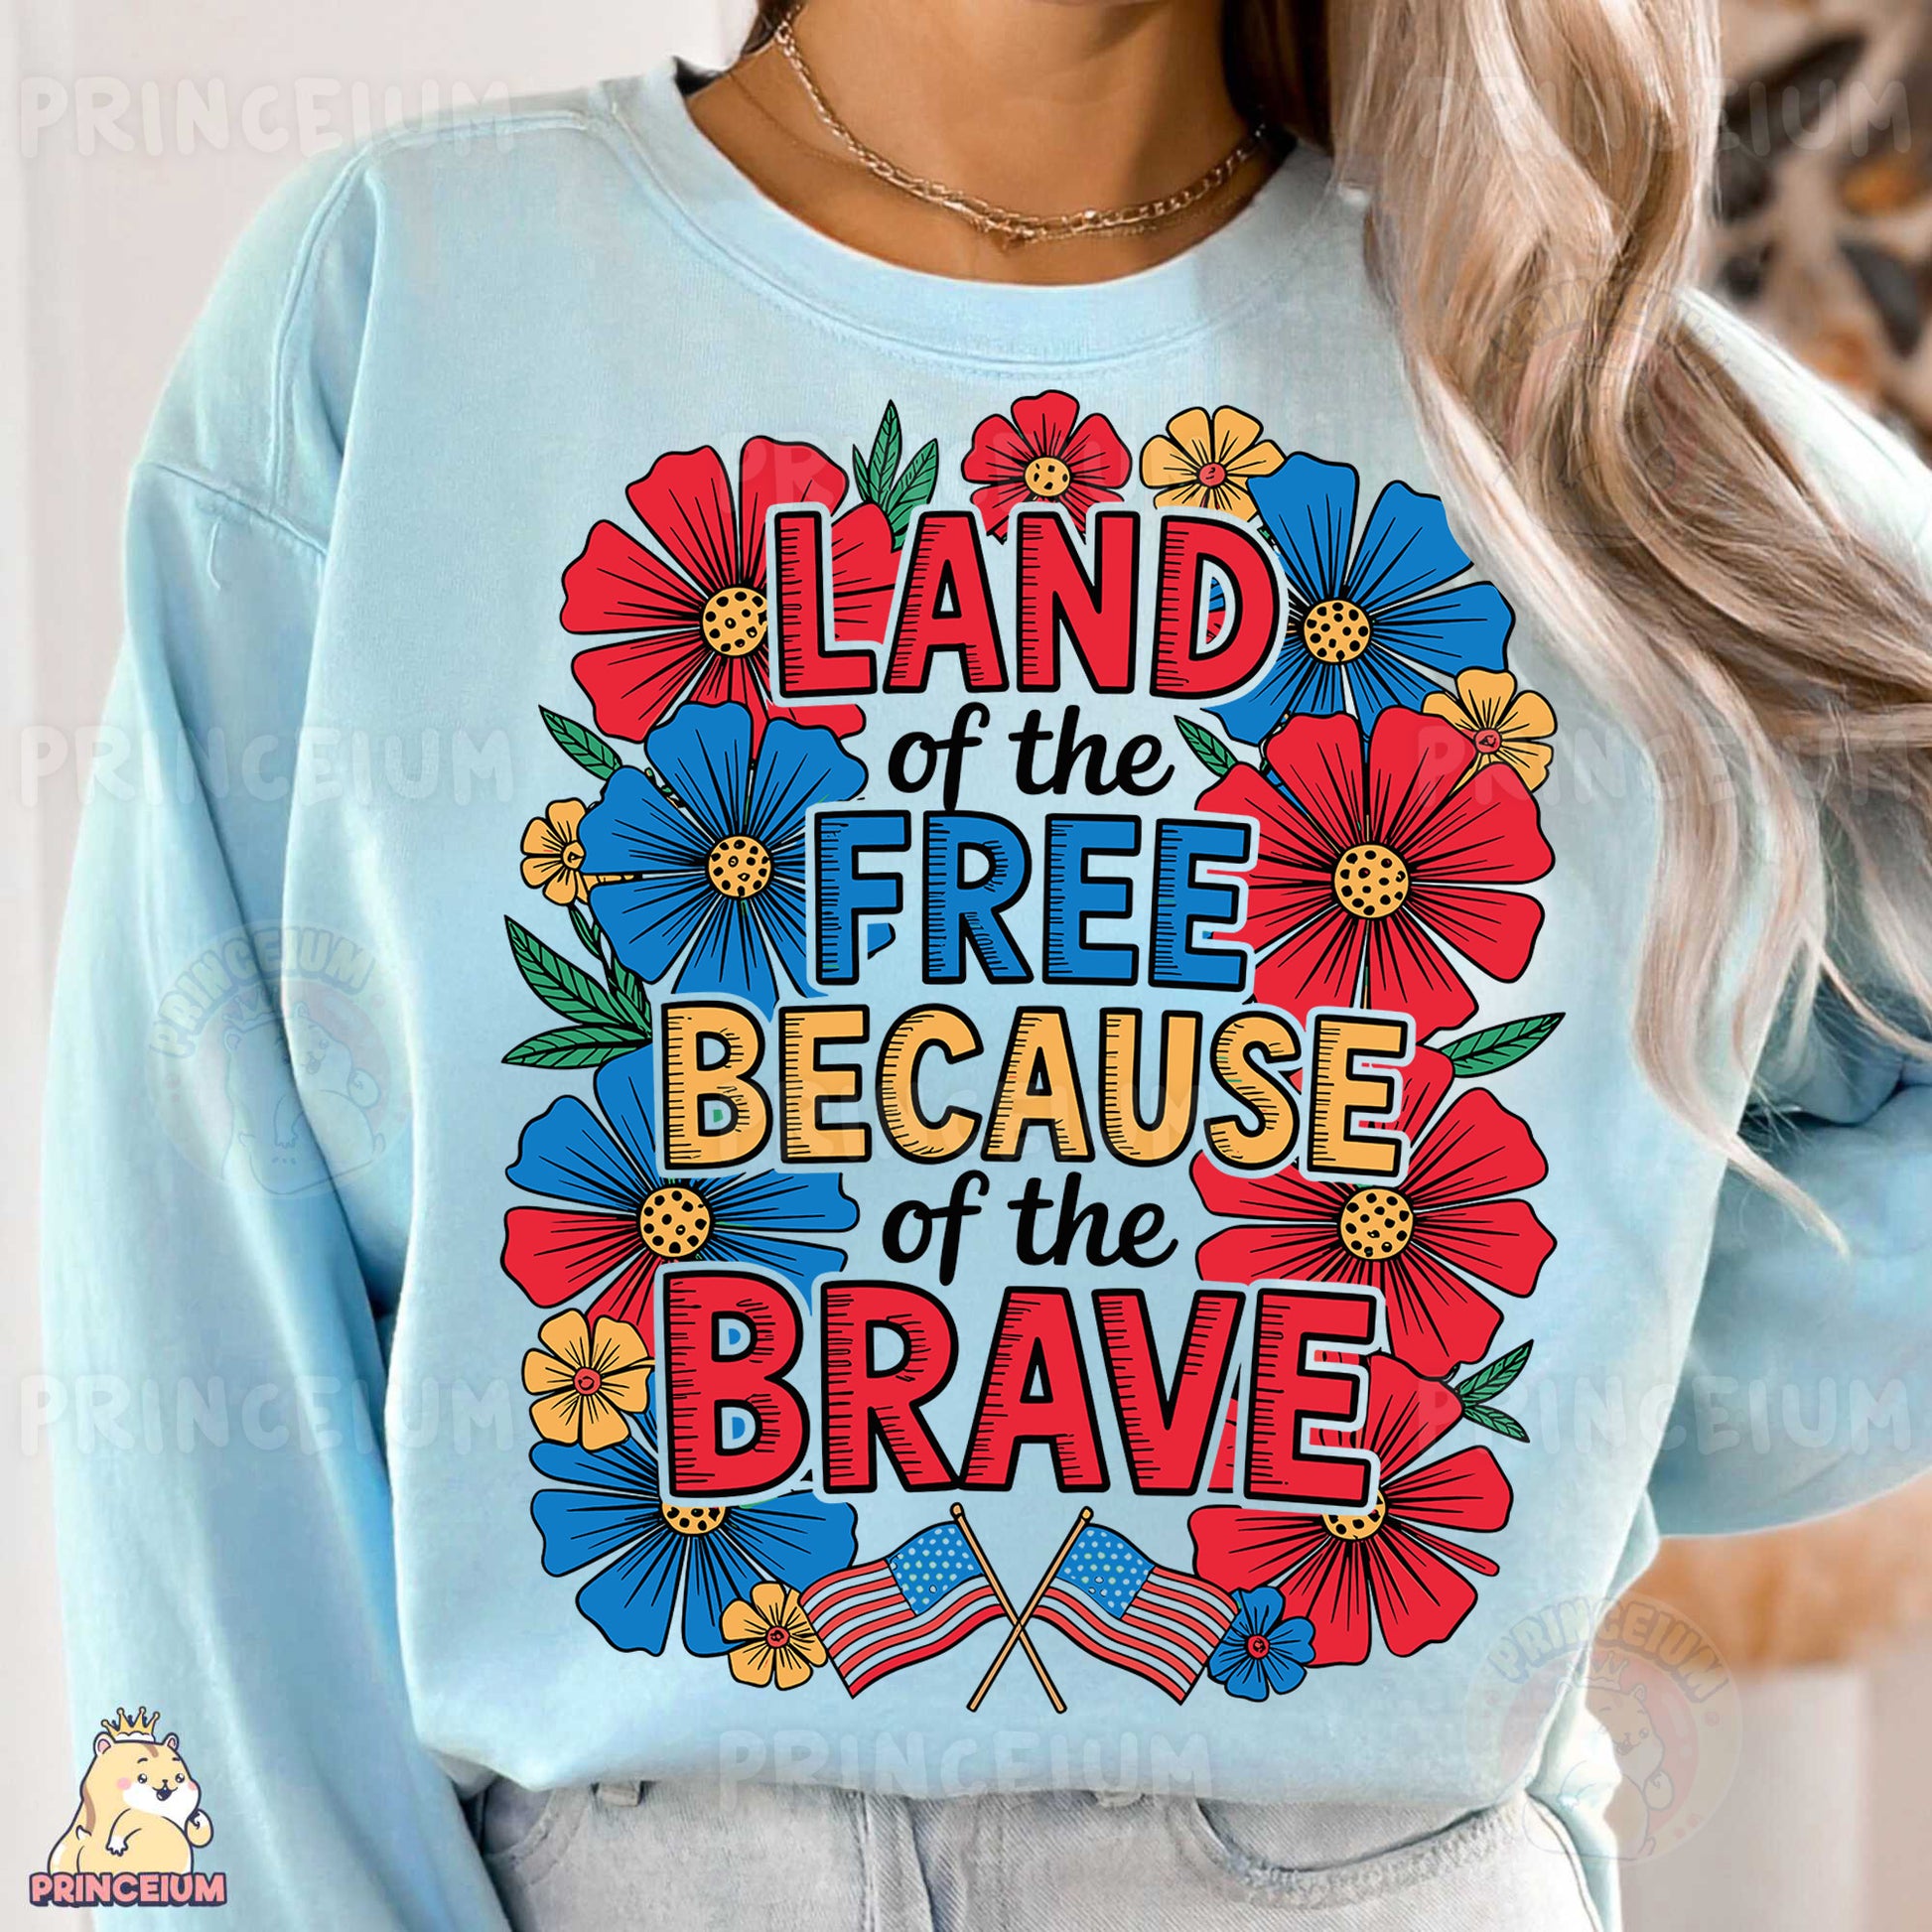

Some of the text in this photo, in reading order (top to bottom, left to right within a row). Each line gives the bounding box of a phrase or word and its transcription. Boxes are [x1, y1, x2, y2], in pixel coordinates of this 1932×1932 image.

[773, 509, 1282, 700] LAND
[888, 702, 1175, 812] of the
[814, 809, 1253, 992] FREE
[662, 1000, 1410, 1177] BECAUSE
[882, 1170, 1178, 1287] of the
[662, 1269, 1378, 1508] BRAVE
